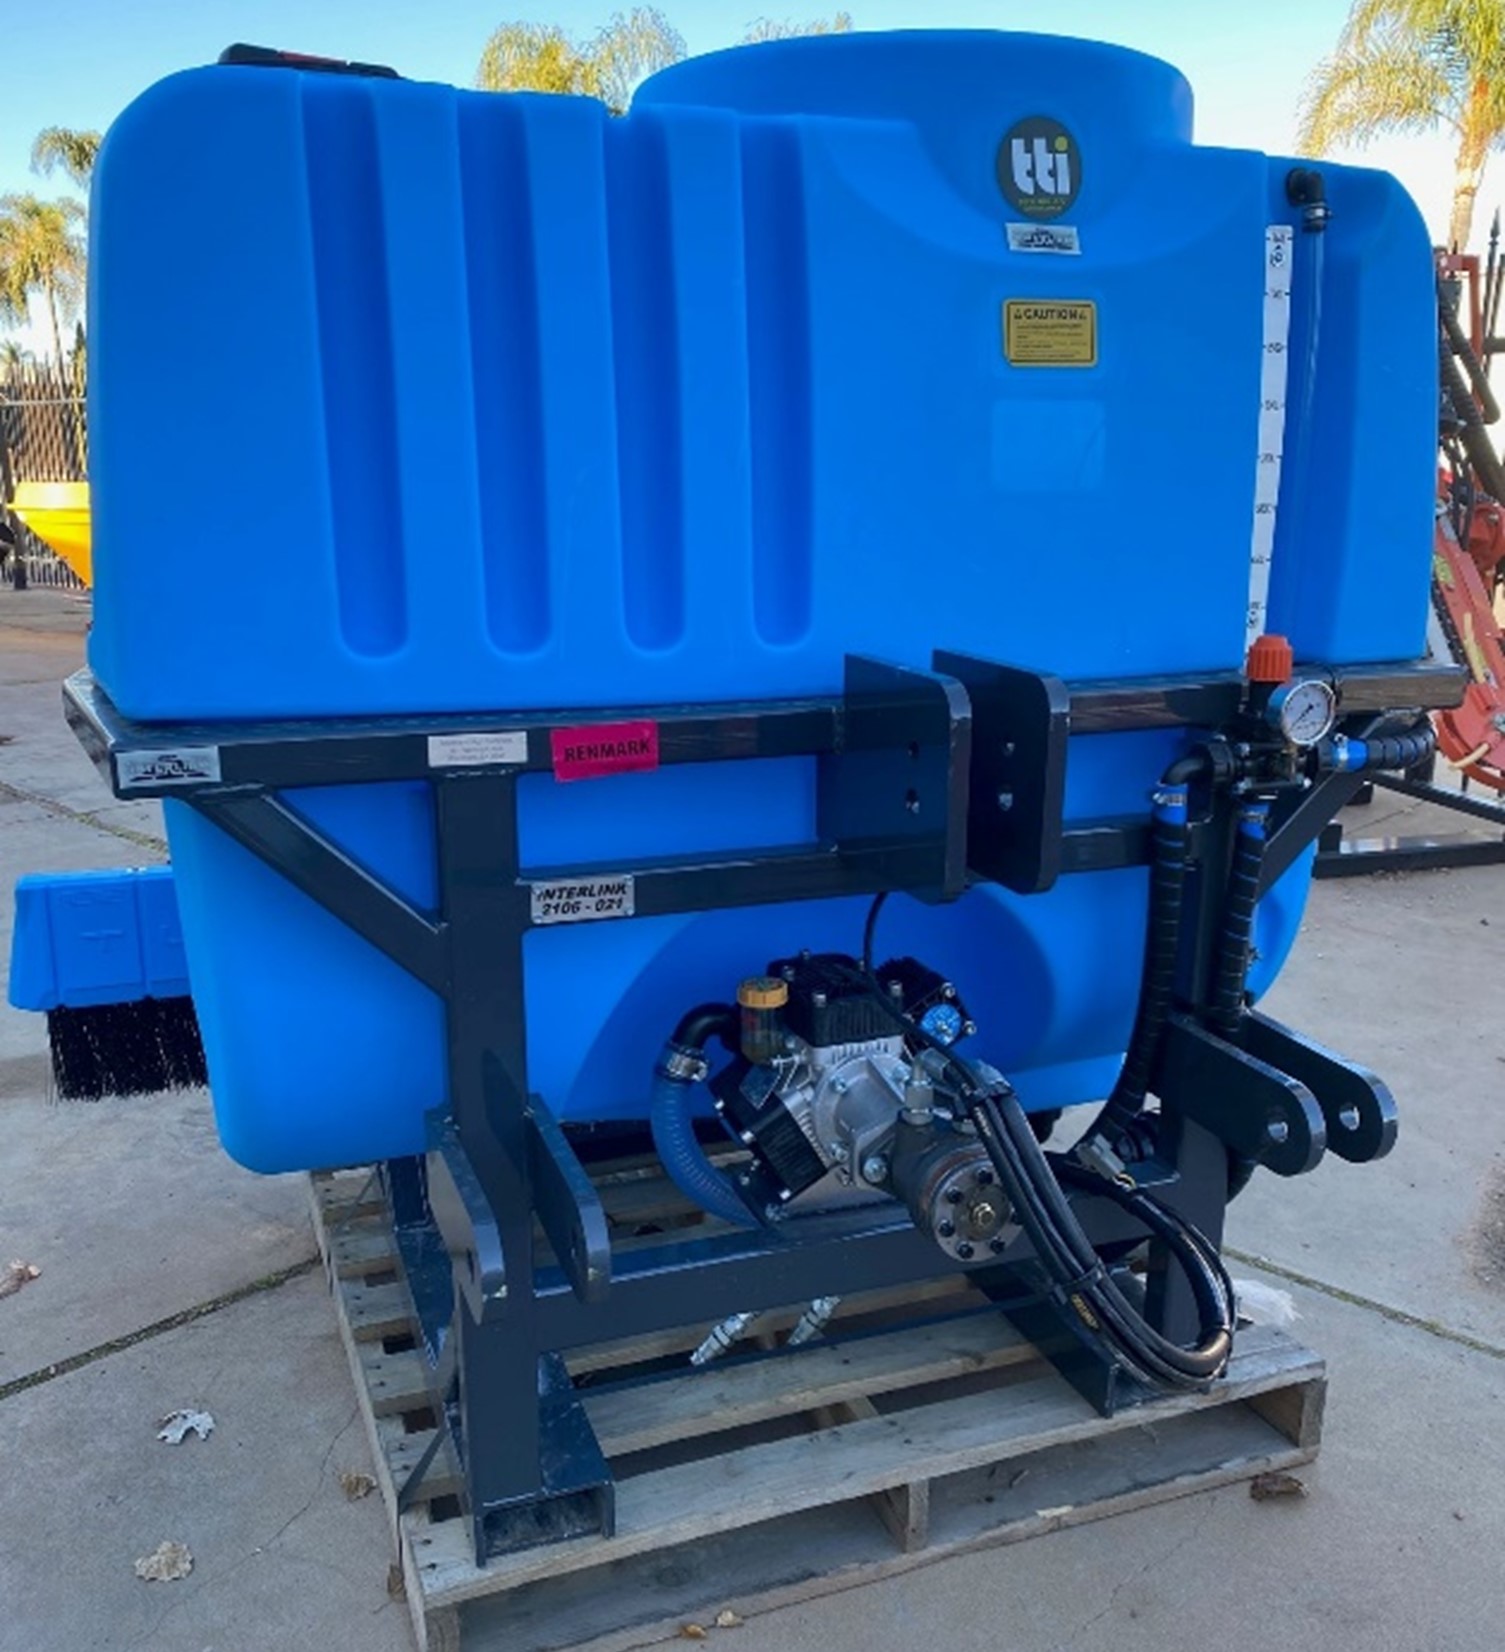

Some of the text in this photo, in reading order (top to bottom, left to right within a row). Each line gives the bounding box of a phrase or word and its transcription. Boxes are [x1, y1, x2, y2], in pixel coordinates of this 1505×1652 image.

[1011, 135, 1071, 195] tti
[1023, 308, 1078, 320] CAUTION
[564, 739, 650, 761] RENMARK
[537, 883, 626, 901] INTERLINK
[542, 901, 581, 915] 2106
[595, 898, 622, 912] 021
